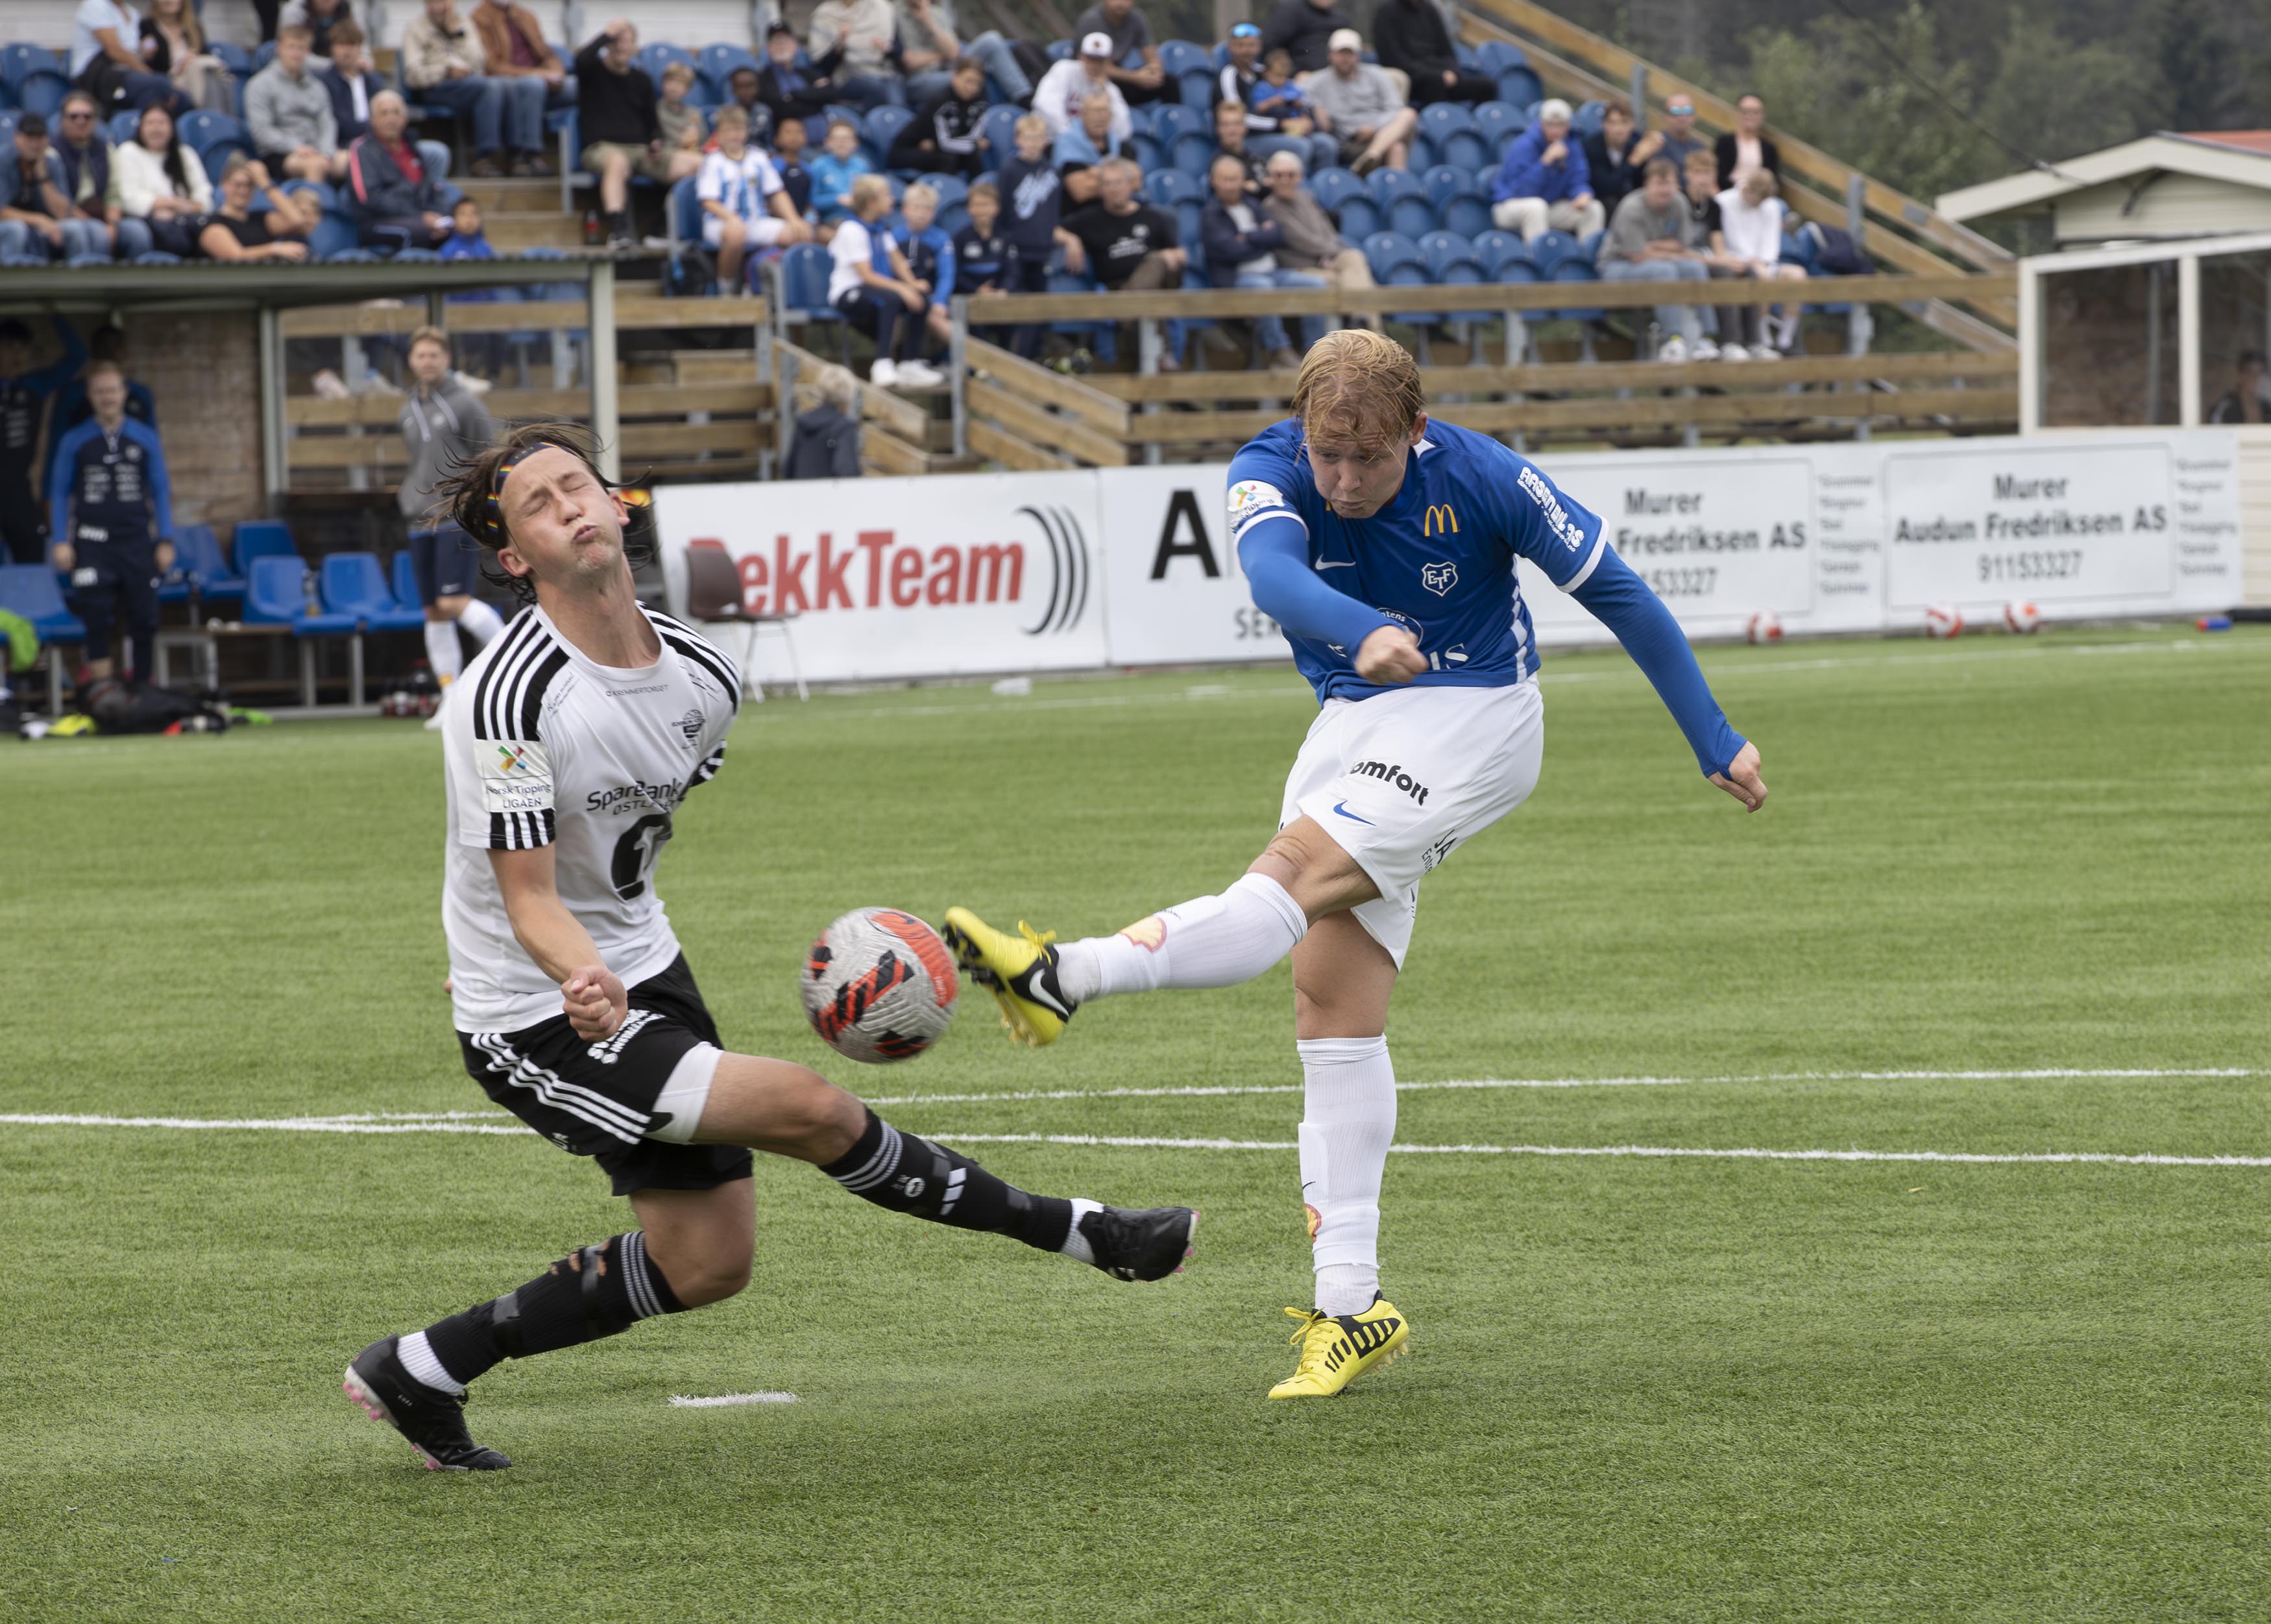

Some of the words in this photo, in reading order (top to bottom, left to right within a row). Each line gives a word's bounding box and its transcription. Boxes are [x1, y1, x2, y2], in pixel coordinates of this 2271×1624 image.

[1625, 488, 1703, 515] Murer
[1994, 474, 2069, 500] Murer
[1895, 516, 1977, 543] Audun
[1984, 509, 2124, 539] Fredriksen
[2132, 503, 2168, 532] AS
[1616, 524, 1760, 556] Fredriksen
[1769, 520, 1807, 550] AS
[690, 529, 1025, 614] ekkTeam
[1978, 550, 2083, 582] 91153327
[1380, 610, 1406, 623] otens
[515, 783, 552, 795] Tipping
[1350, 760, 1429, 806] omfort
[504, 797, 541, 808] LIGAEN
